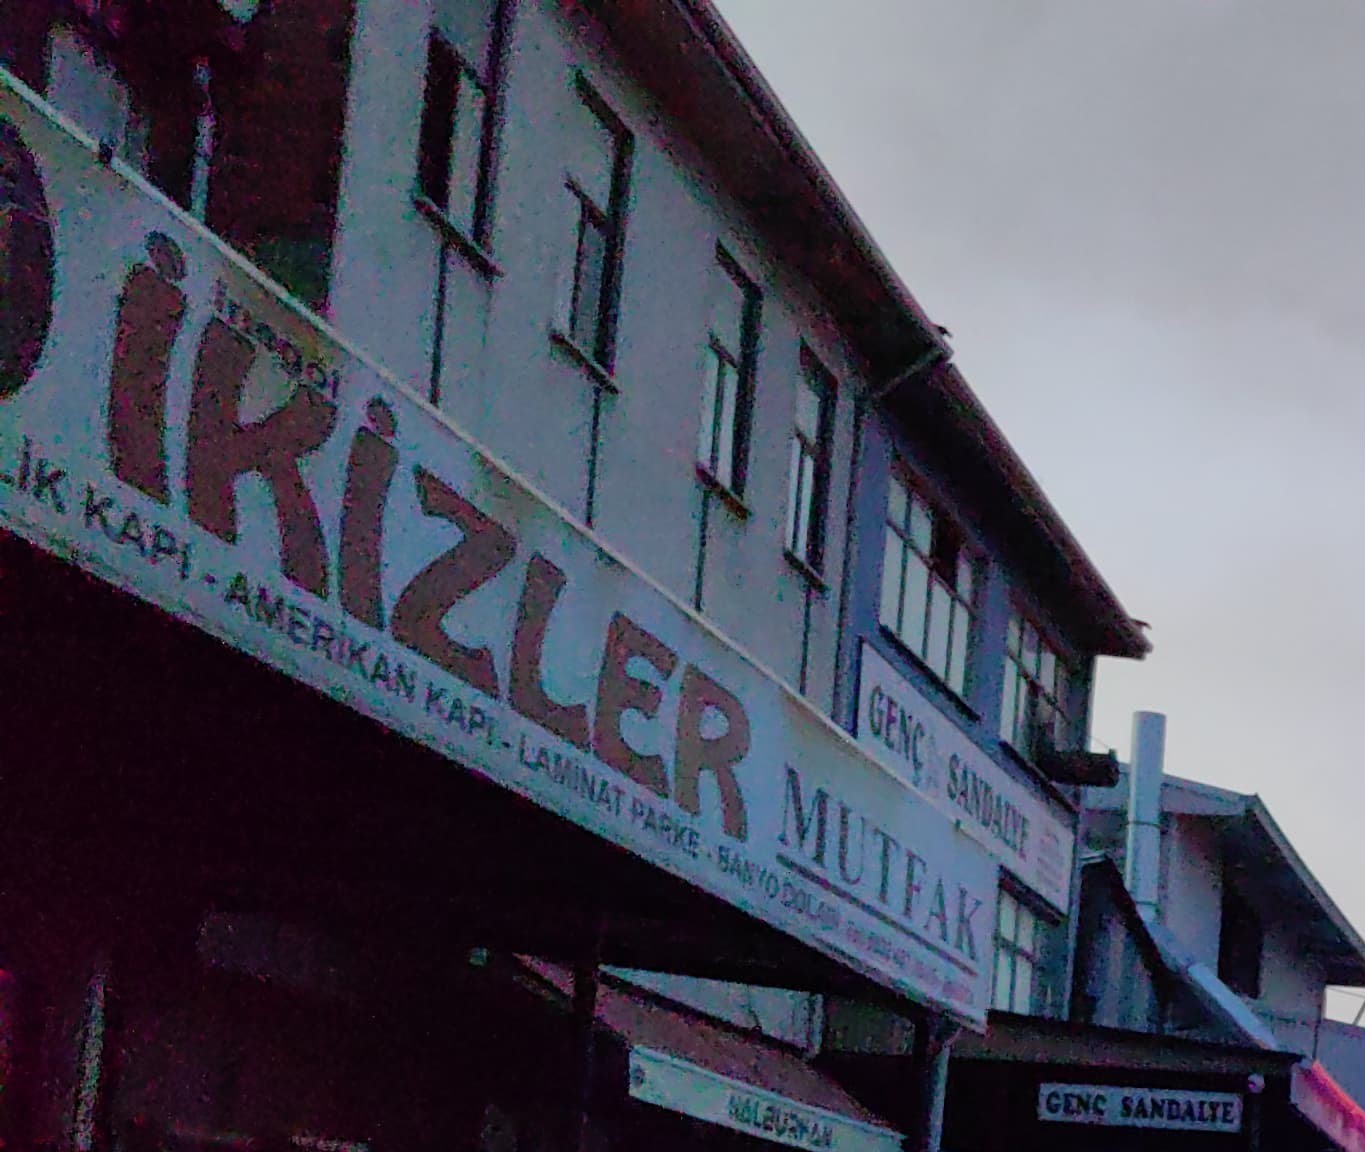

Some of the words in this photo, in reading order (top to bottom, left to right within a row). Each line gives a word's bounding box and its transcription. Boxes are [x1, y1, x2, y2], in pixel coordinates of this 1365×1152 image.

[84, 480, 190, 580] KAPI
[777, 760, 984, 964] MUTFAK
[1119, 1095, 1236, 1125] SANDALYE
